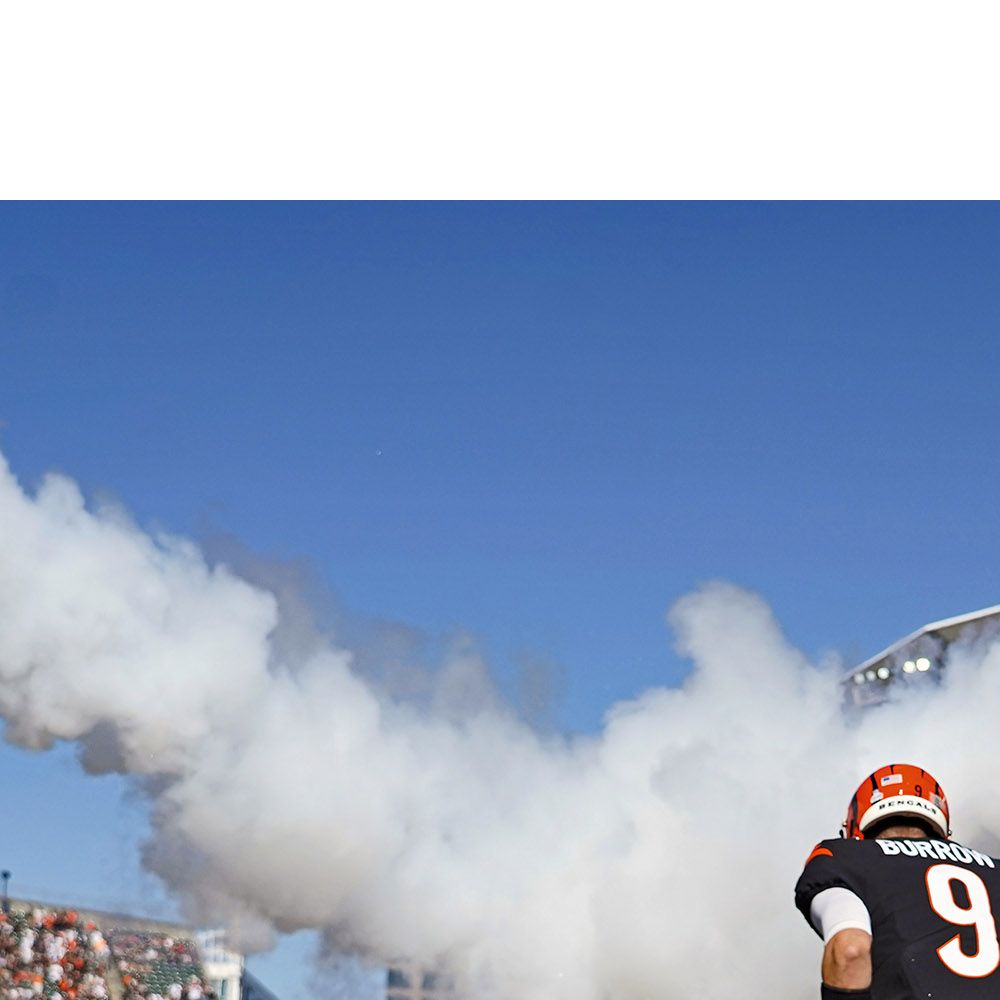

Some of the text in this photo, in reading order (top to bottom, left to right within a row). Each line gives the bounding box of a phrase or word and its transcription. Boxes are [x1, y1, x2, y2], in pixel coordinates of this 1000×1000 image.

[914, 784, 923, 798] 9
[879, 800, 937, 815] BENGALS
[875, 839, 996, 868] BURROW
[925, 863, 1000, 978] 9
